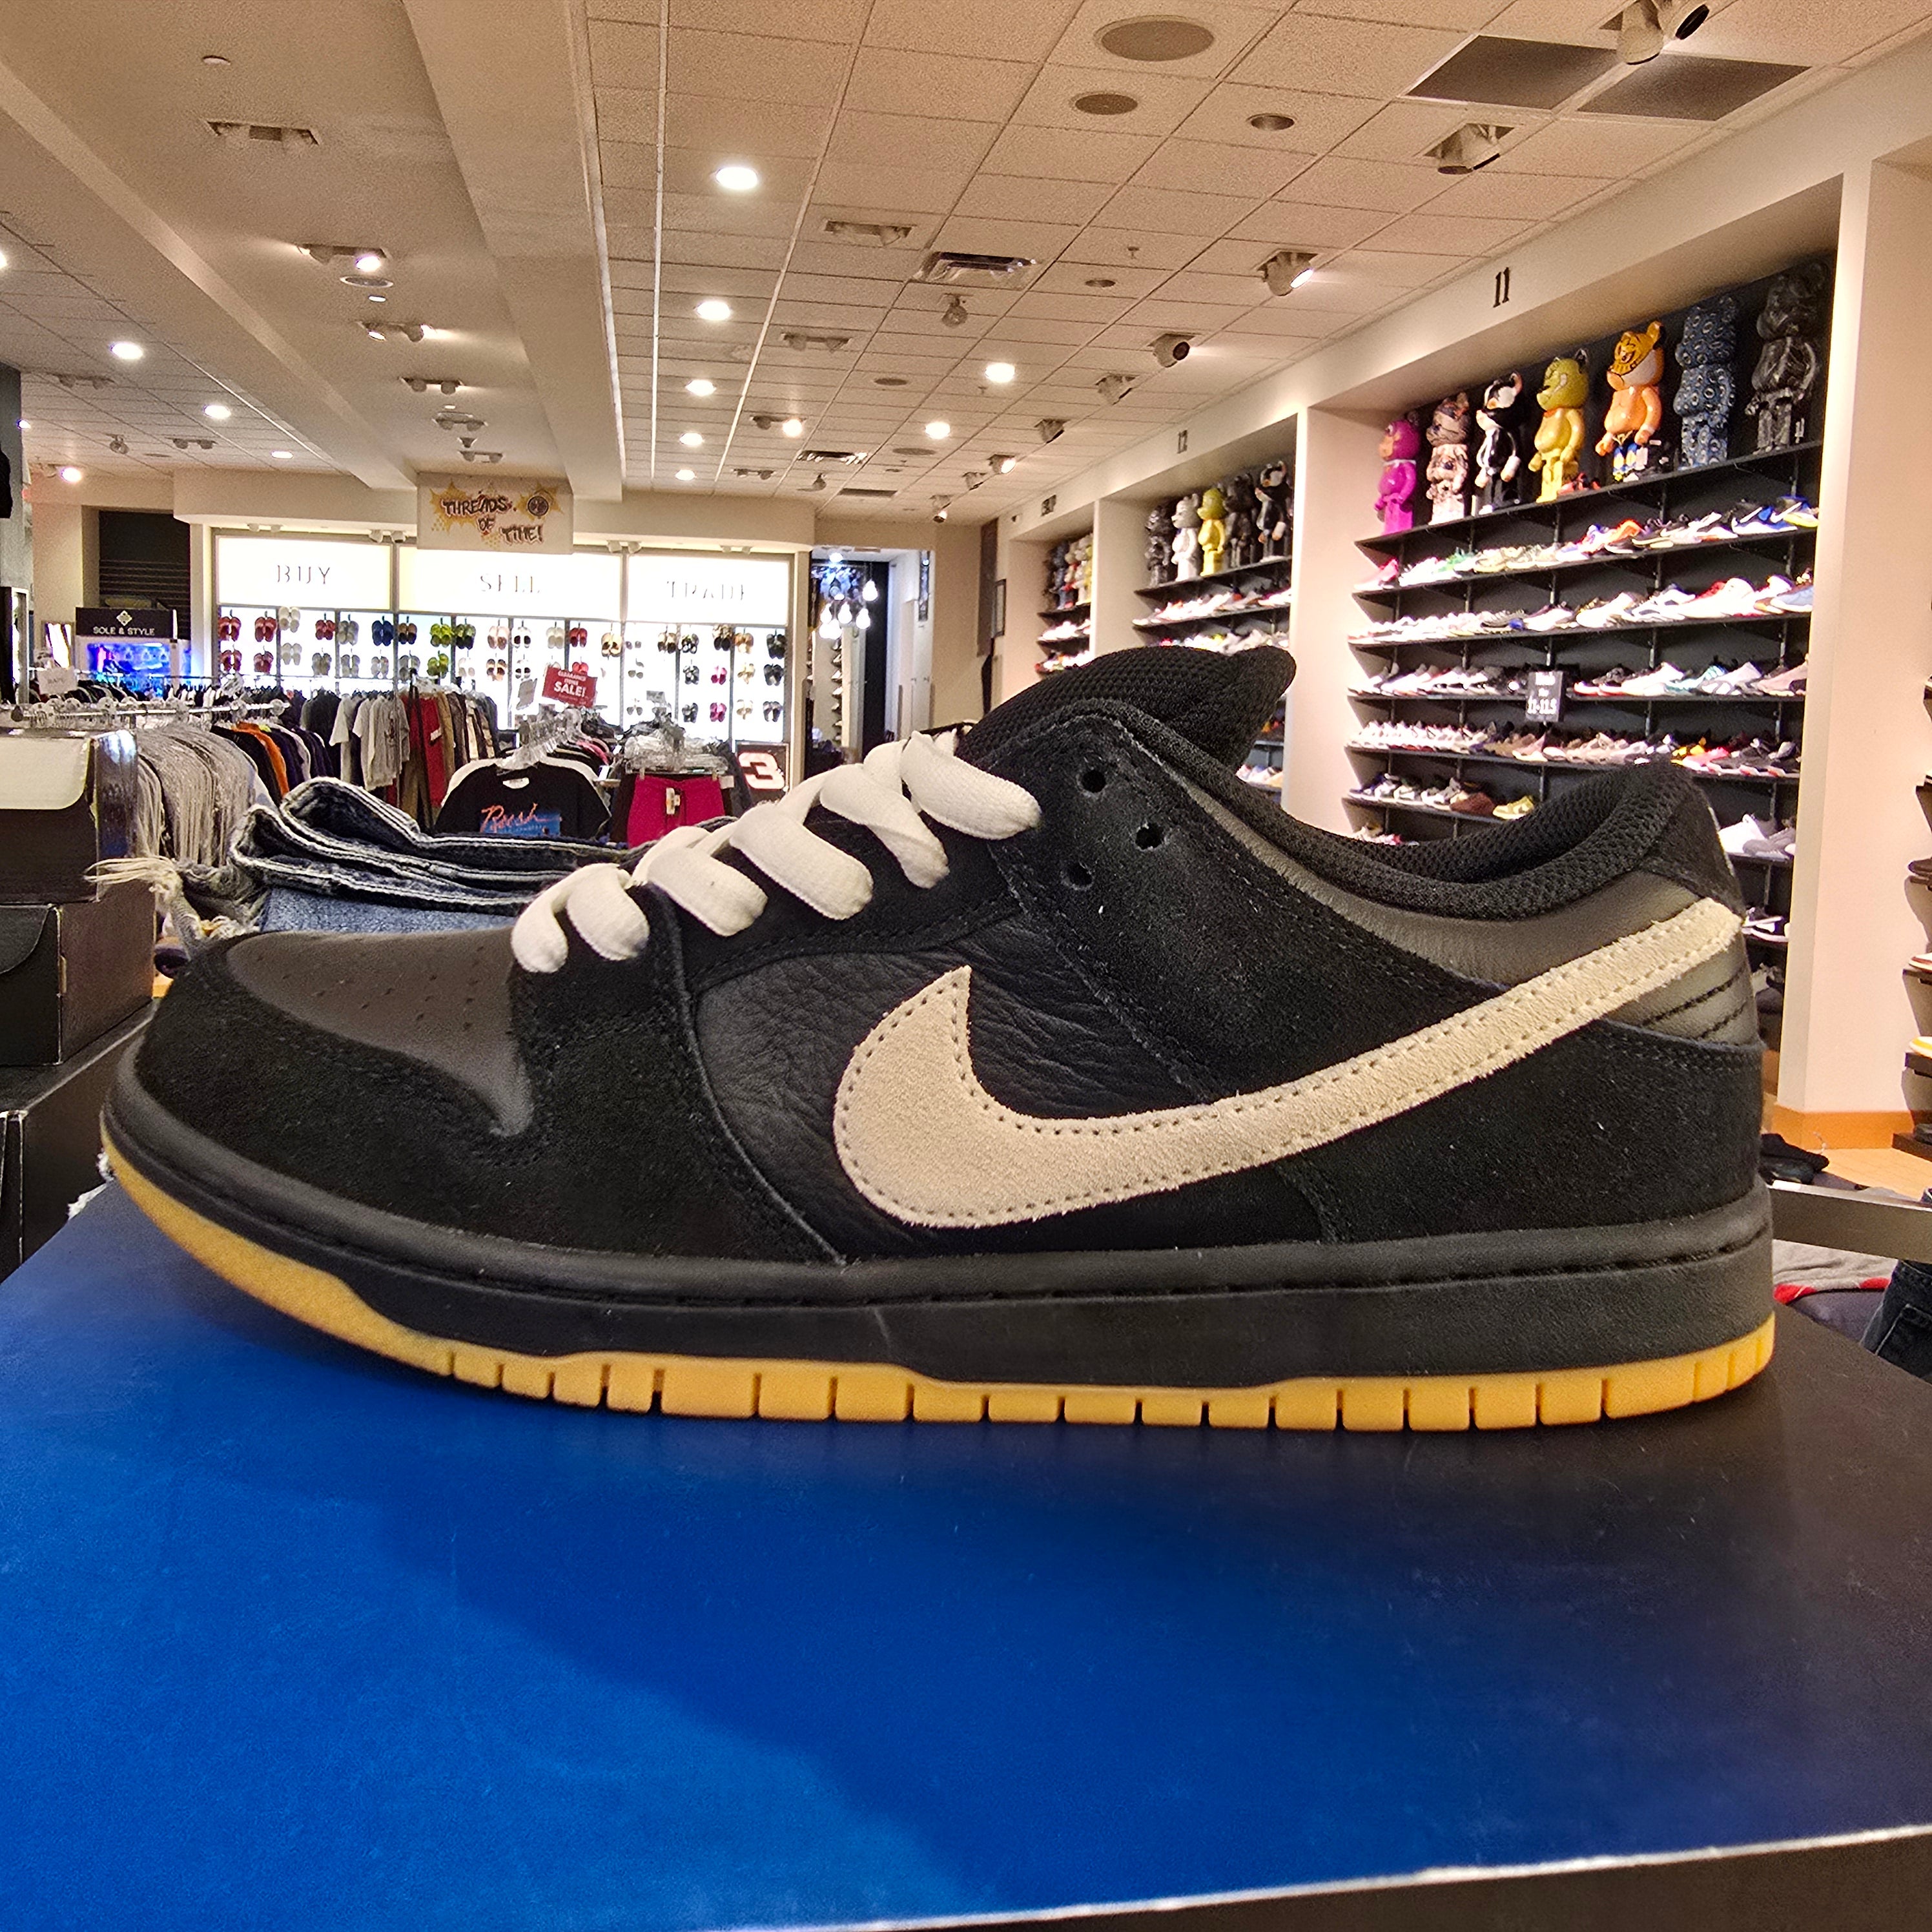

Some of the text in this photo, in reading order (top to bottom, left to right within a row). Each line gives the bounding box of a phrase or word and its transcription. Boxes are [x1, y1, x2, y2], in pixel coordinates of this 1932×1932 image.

[1493, 267, 1510, 308] 11
[442, 494, 509, 516] THREADS
[276, 564, 331, 584] BUY
[93, 626, 116, 635] SOLE
[127, 628, 155, 636] STYLE
[553, 681, 587, 698] SALE!
[738, 752, 785, 790] 3
